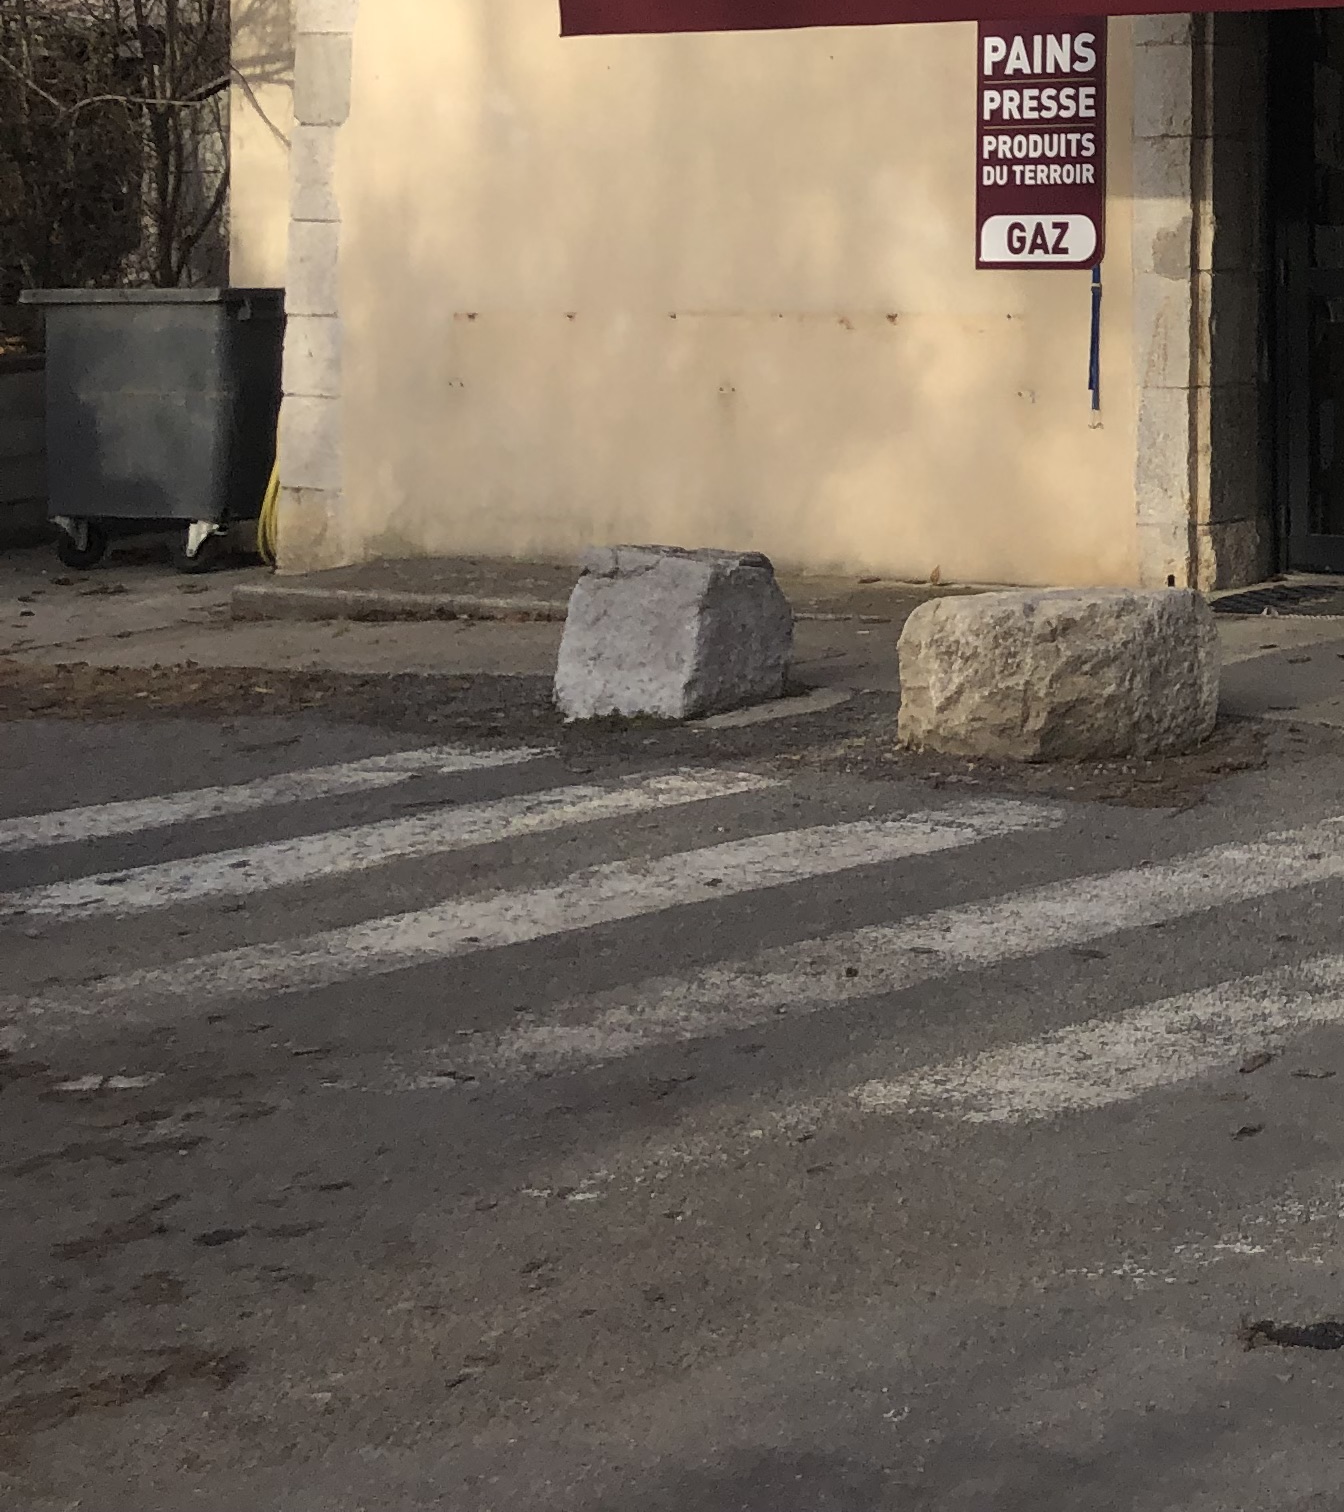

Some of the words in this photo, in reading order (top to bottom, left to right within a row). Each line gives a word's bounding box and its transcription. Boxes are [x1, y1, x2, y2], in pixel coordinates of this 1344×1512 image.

[983, 32, 1097, 76] PAINS
[983, 86, 1096, 121] PRESSE
[982, 133, 1096, 160] PRODUITS
[982, 165, 1008, 186] DU
[1012, 163, 1095, 186] TERROIR
[1006, 221, 1070, 256] GAZ
